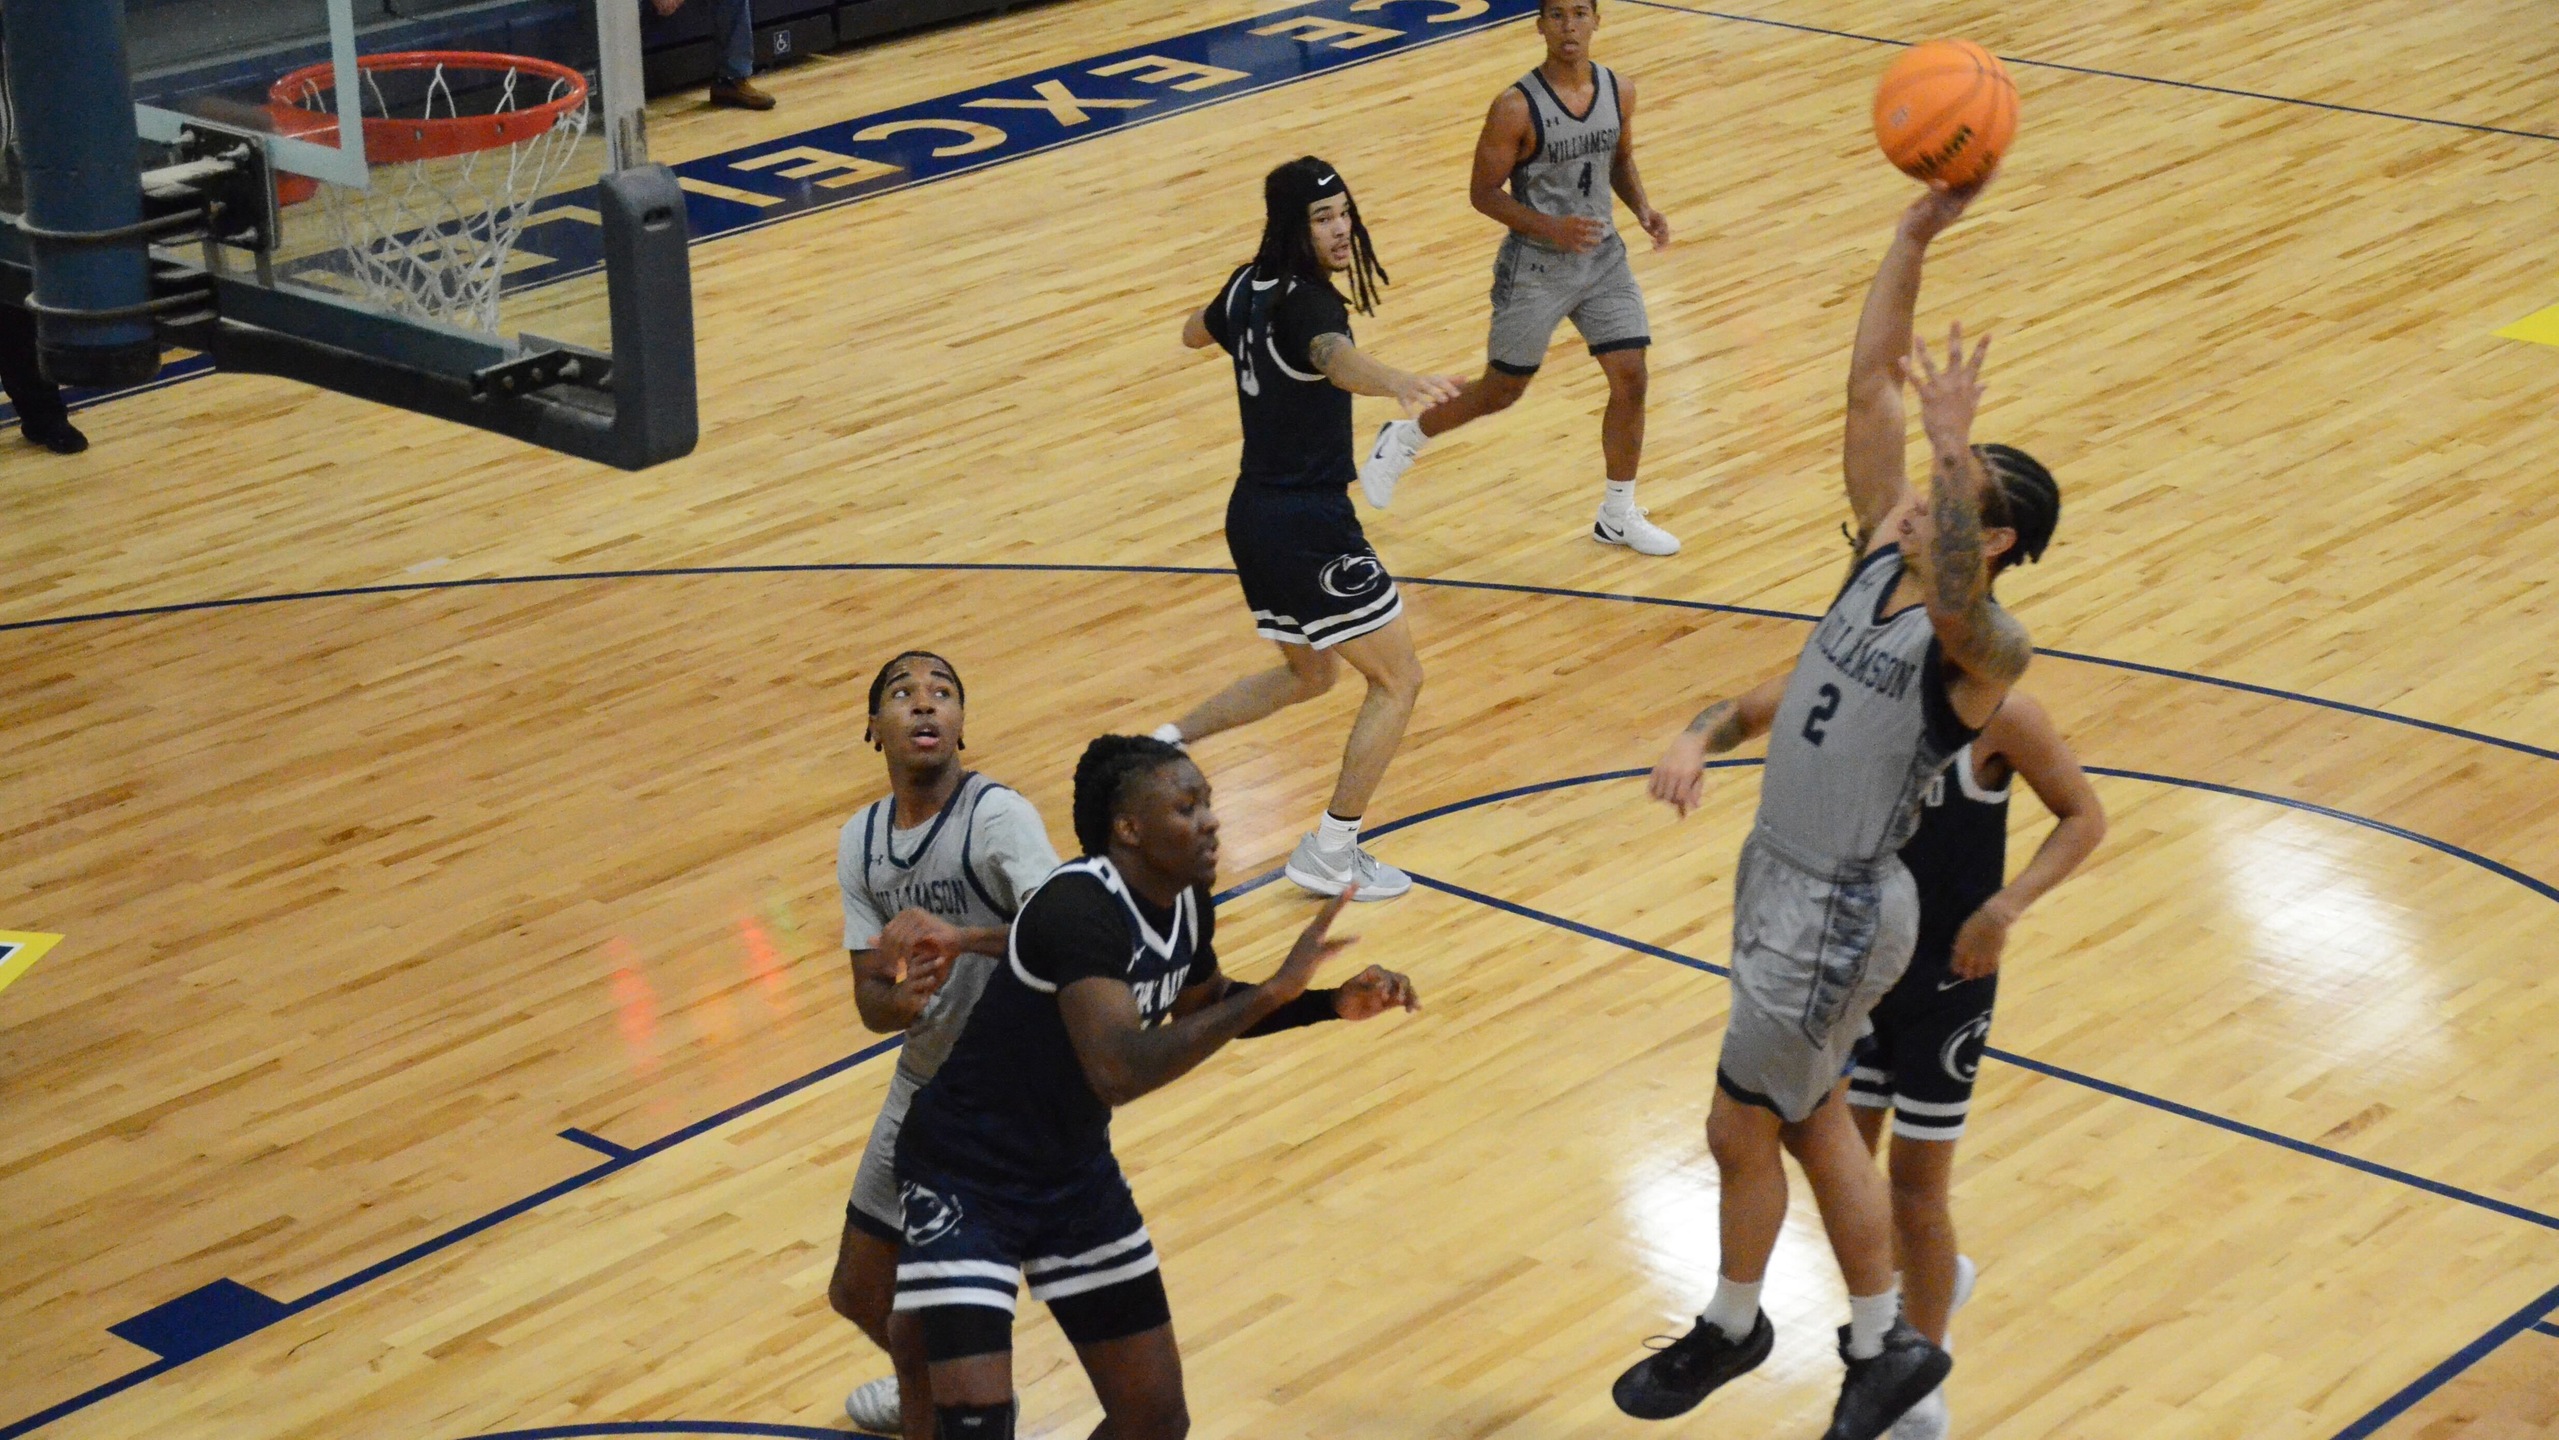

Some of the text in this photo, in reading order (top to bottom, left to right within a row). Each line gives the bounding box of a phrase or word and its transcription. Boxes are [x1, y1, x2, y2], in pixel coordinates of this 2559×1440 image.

[1578, 161, 1593, 198] 4
[1815, 614, 1917, 701] ILLAMSON
[1802, 682, 1841, 747] 2
[875, 880, 969, 917] WILAMSON
